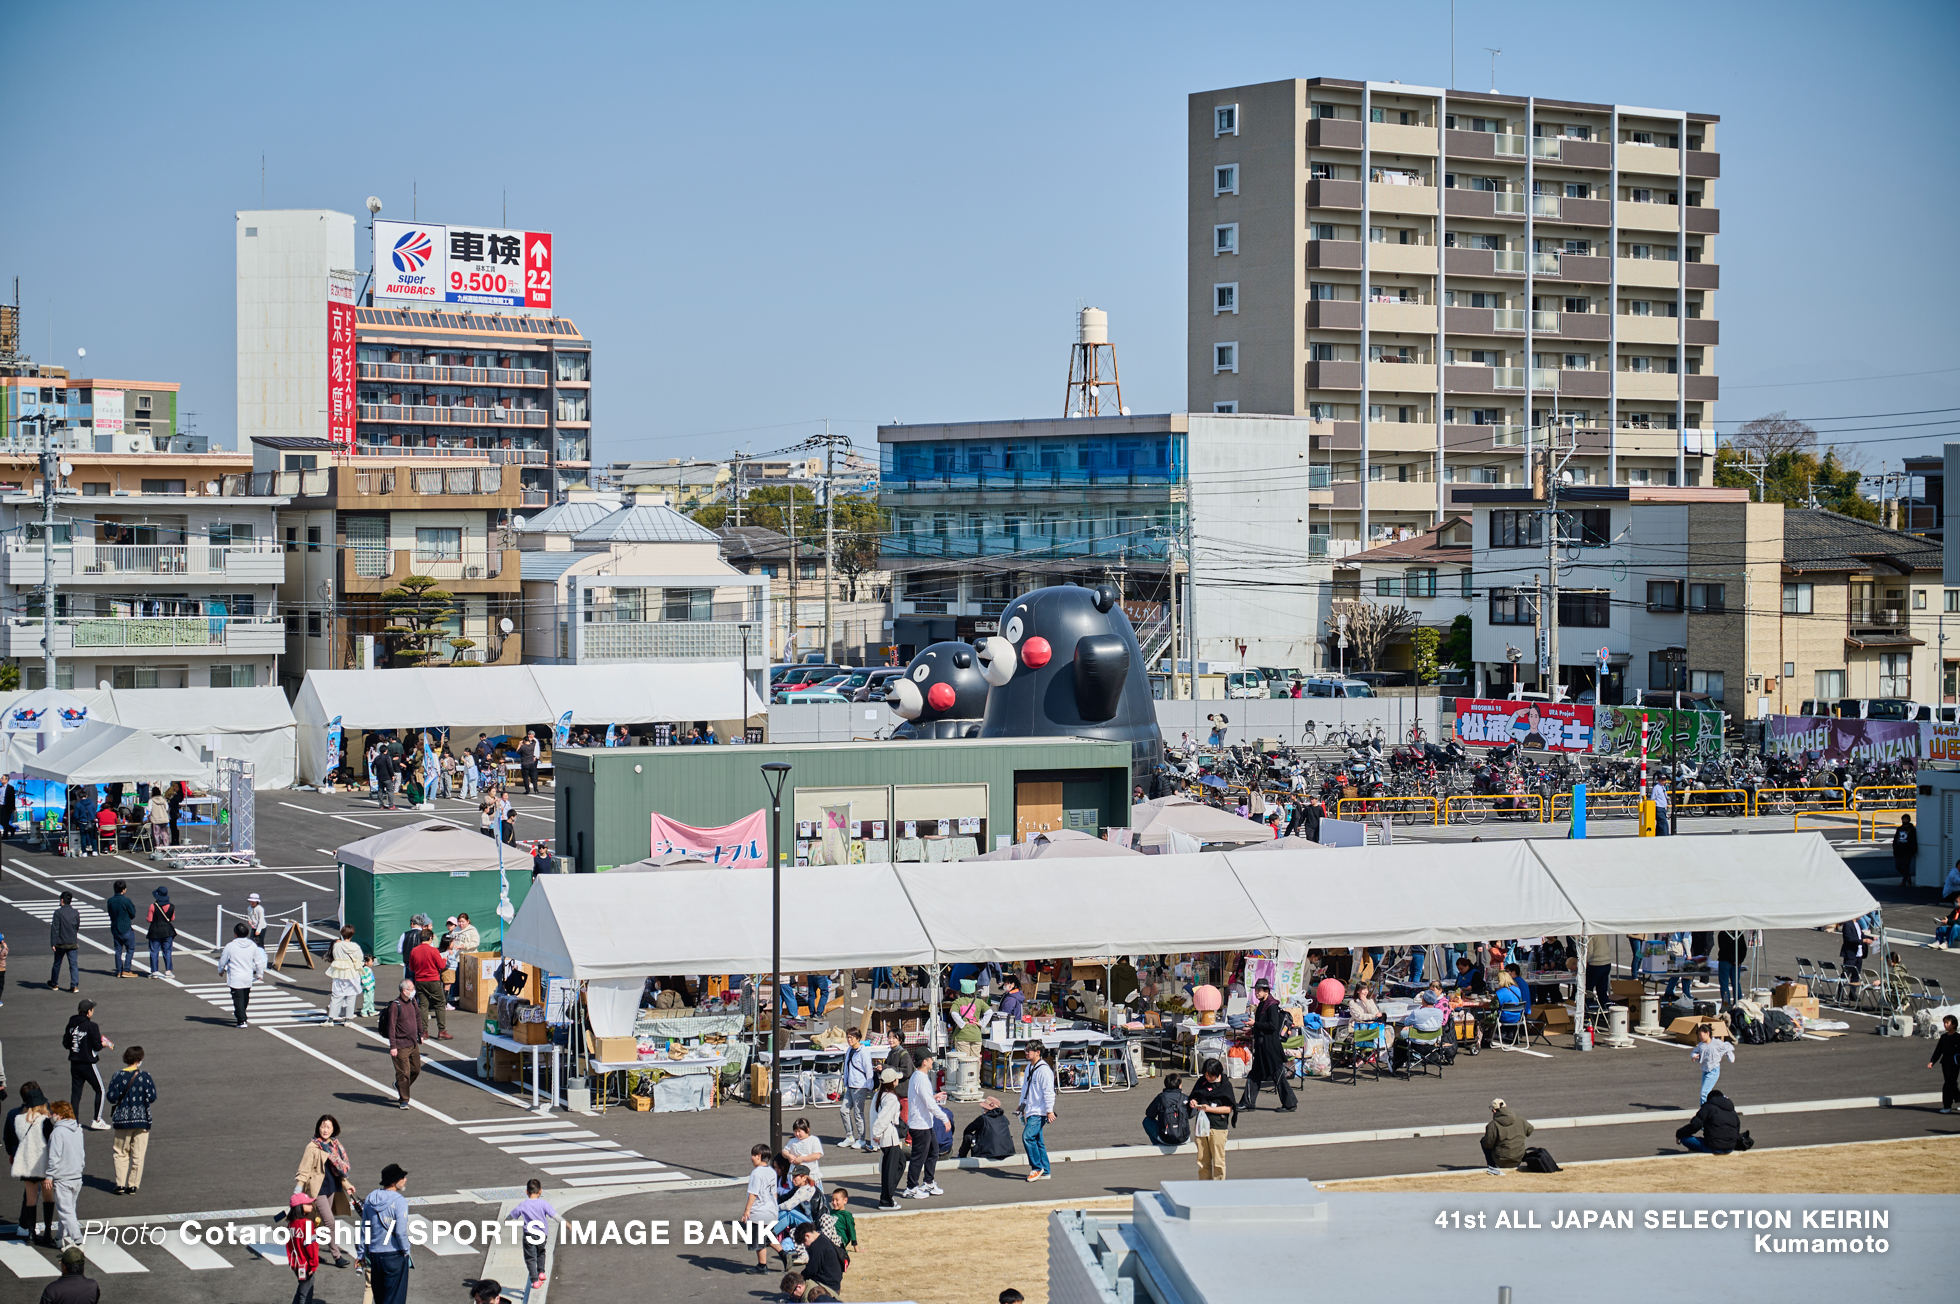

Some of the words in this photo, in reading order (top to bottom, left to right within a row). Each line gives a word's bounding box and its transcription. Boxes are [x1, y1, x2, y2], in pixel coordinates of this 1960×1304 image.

[450, 232, 520, 265] 車検
[450, 271, 507, 293] 9,500
[527, 270, 551, 290] 2.2
[386, 284, 436, 296] AUTOBACS
[532, 290, 547, 302] km
[1470, 704, 1495, 712] HIROSHIMA
[1559, 710, 1575, 718] Project
[1932, 726, 1959, 736] 14417
